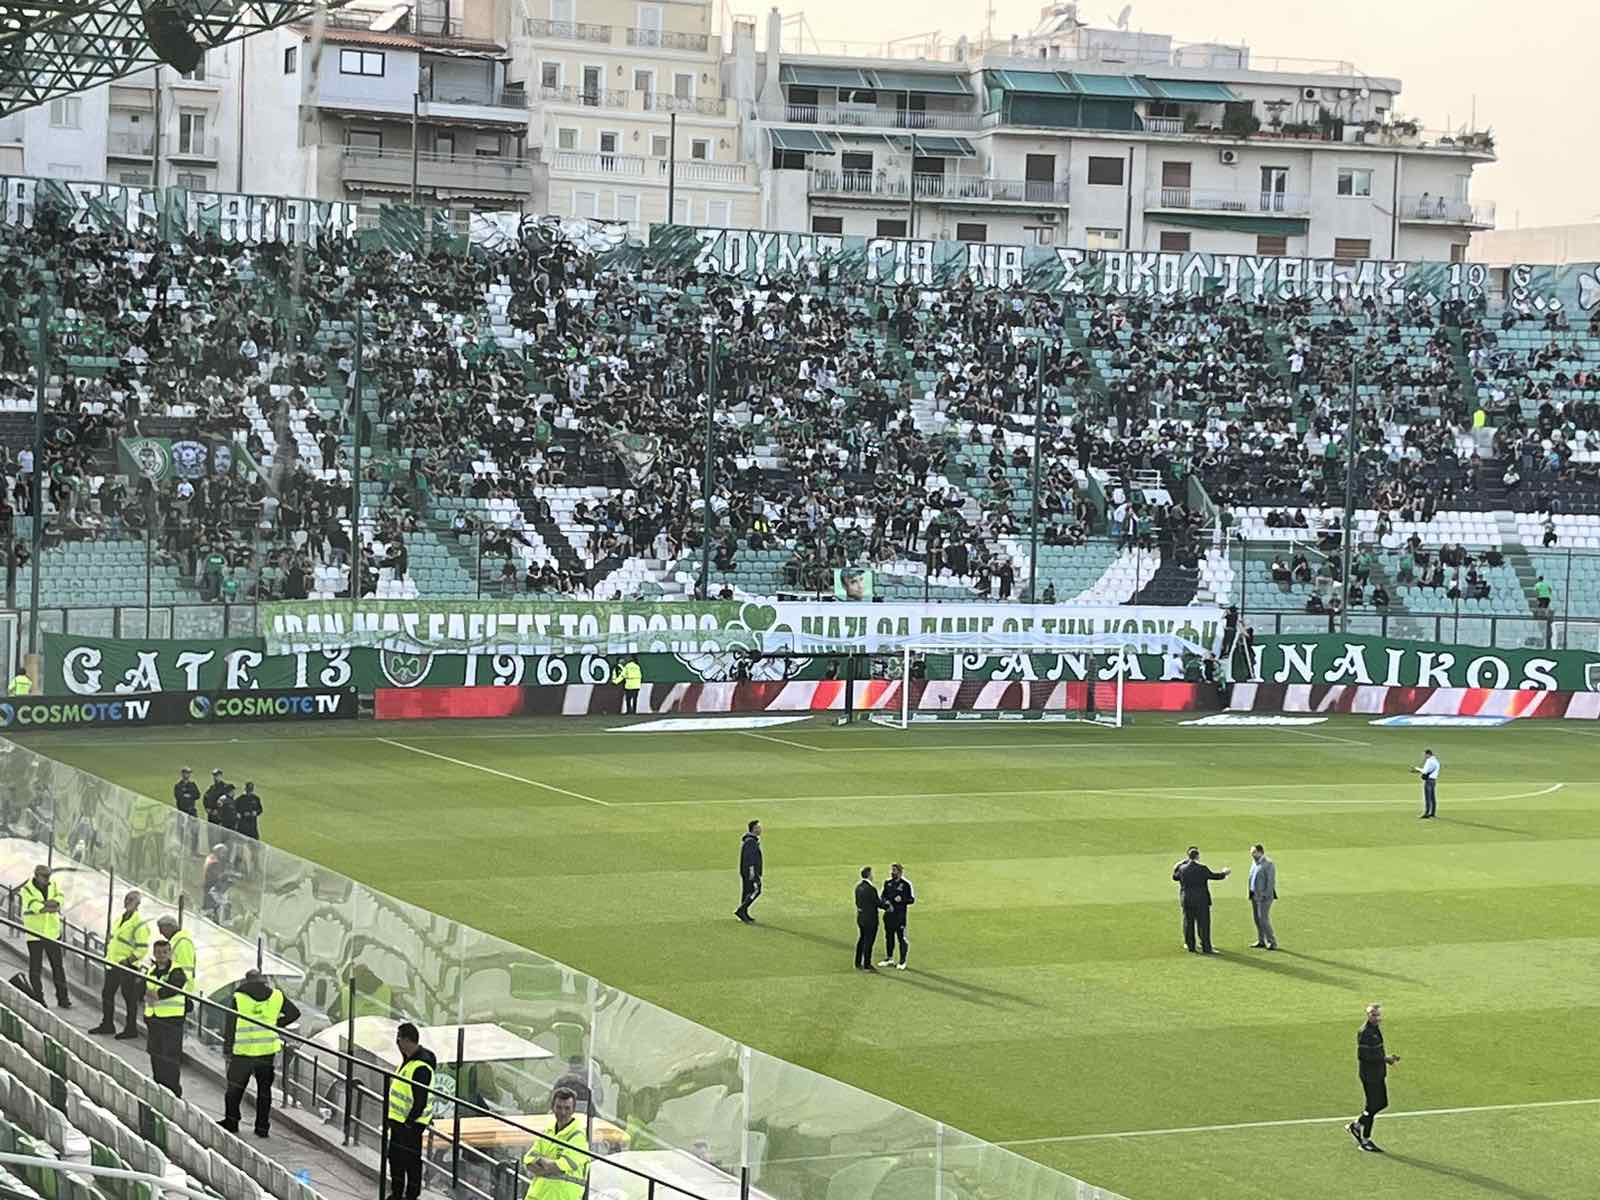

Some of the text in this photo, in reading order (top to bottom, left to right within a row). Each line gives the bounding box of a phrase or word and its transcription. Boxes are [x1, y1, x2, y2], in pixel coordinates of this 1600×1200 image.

[866, 238, 935, 287] ΓΙΑ
[967, 243, 1025, 290] ΝΑ
[62, 647, 352, 695] GATE 13
[464, 653, 612, 687] 1966
[17, 701, 151, 725] COSMOTE TV
[215, 694, 342, 716] COSMOTE TV
